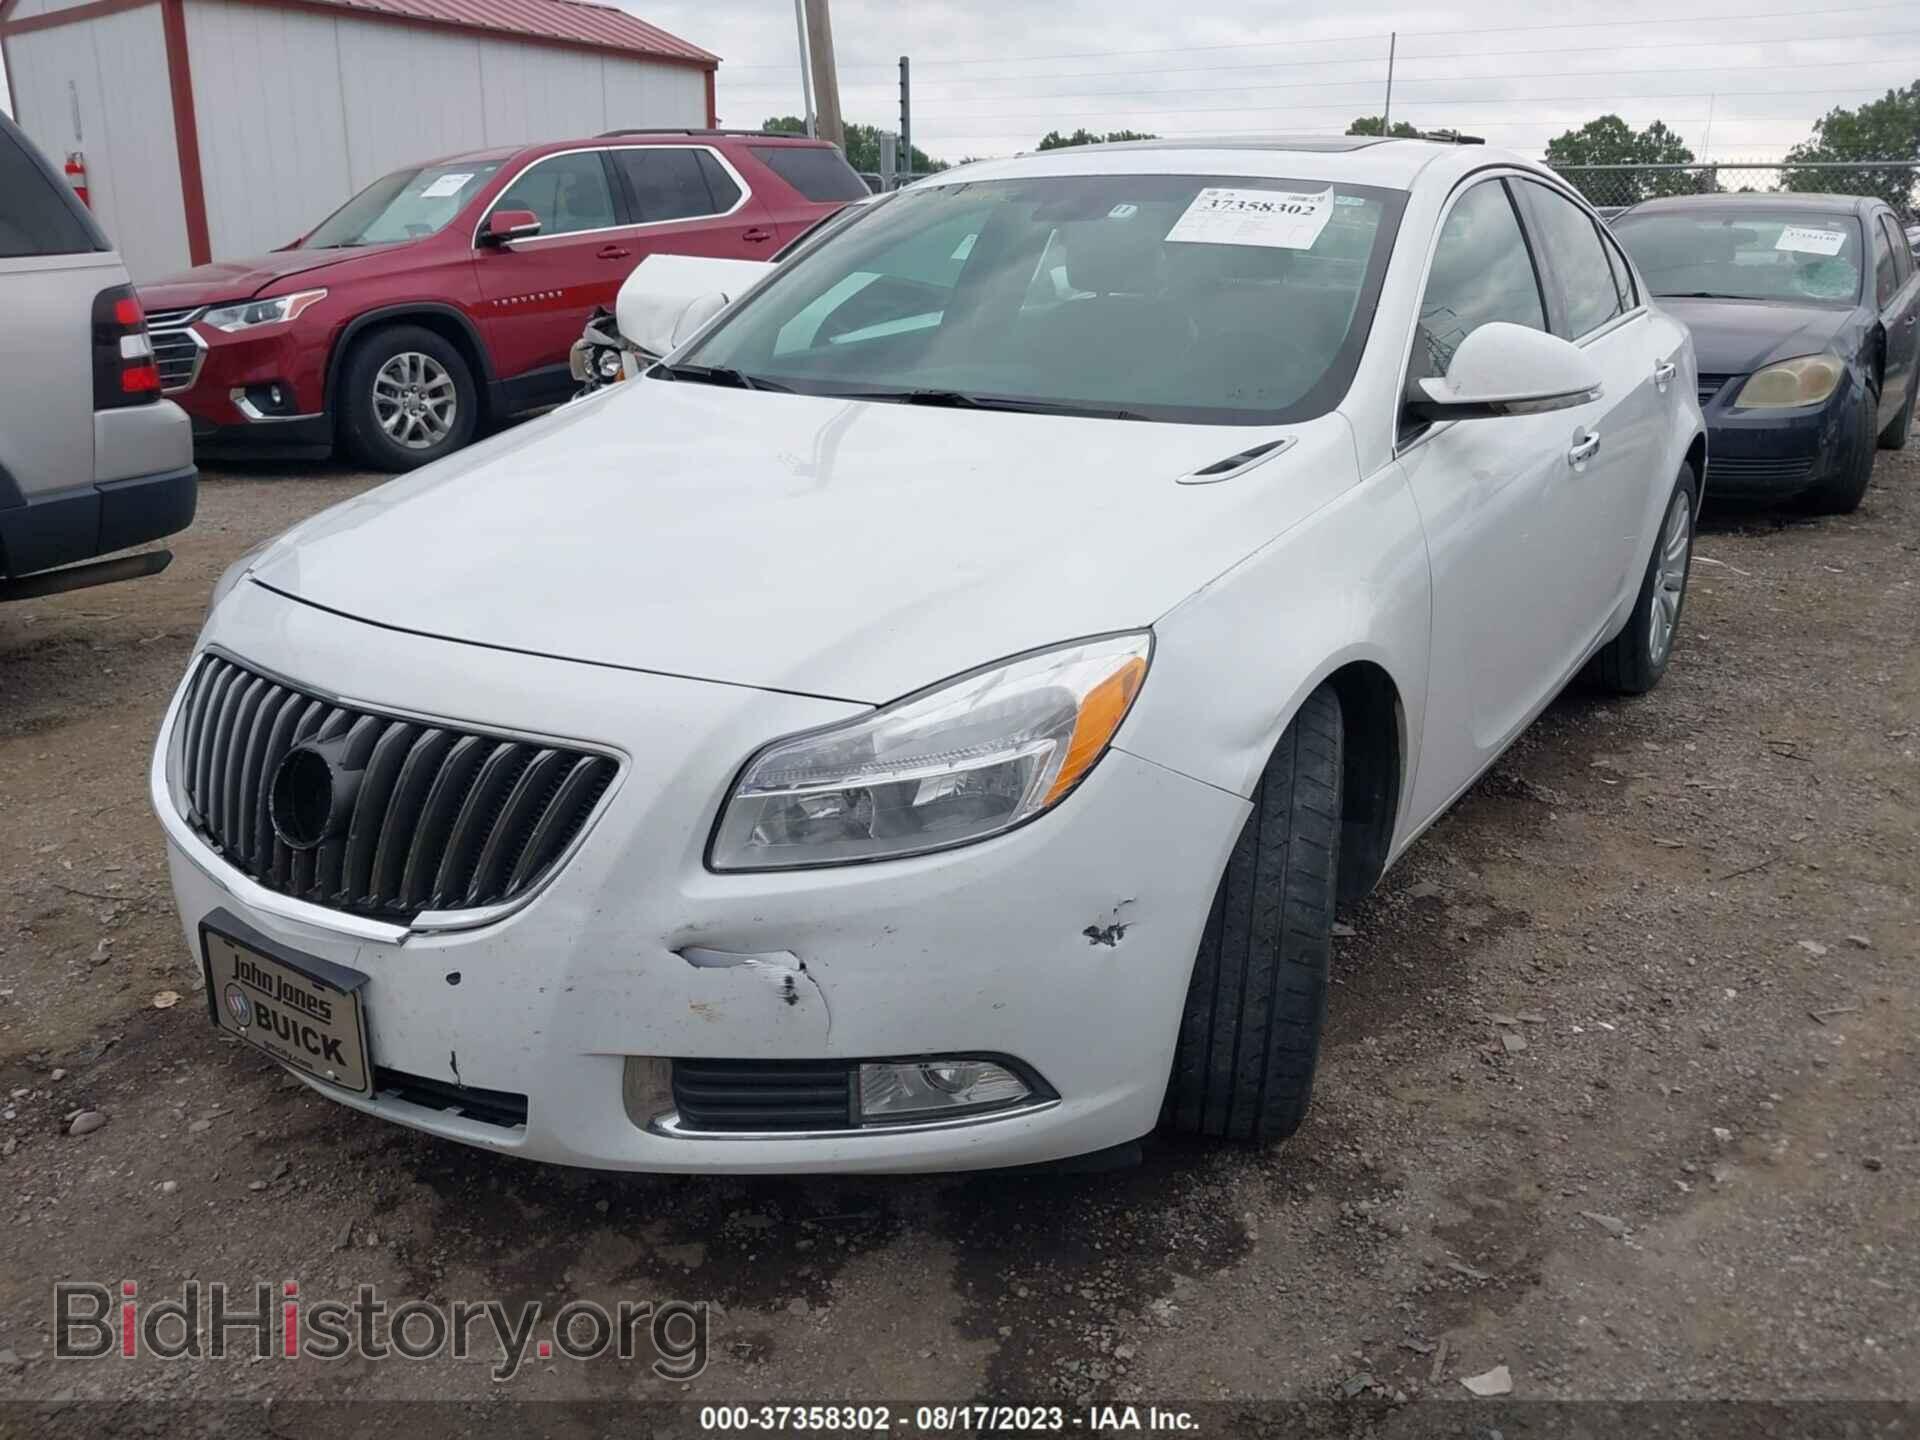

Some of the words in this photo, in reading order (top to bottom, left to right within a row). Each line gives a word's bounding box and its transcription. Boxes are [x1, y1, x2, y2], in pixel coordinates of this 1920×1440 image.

[1203, 199, 1316, 216] 37358302
[232, 954, 274, 992] John
[273, 976, 333, 1019] Jones
[254, 1002, 347, 1066] BUICK
